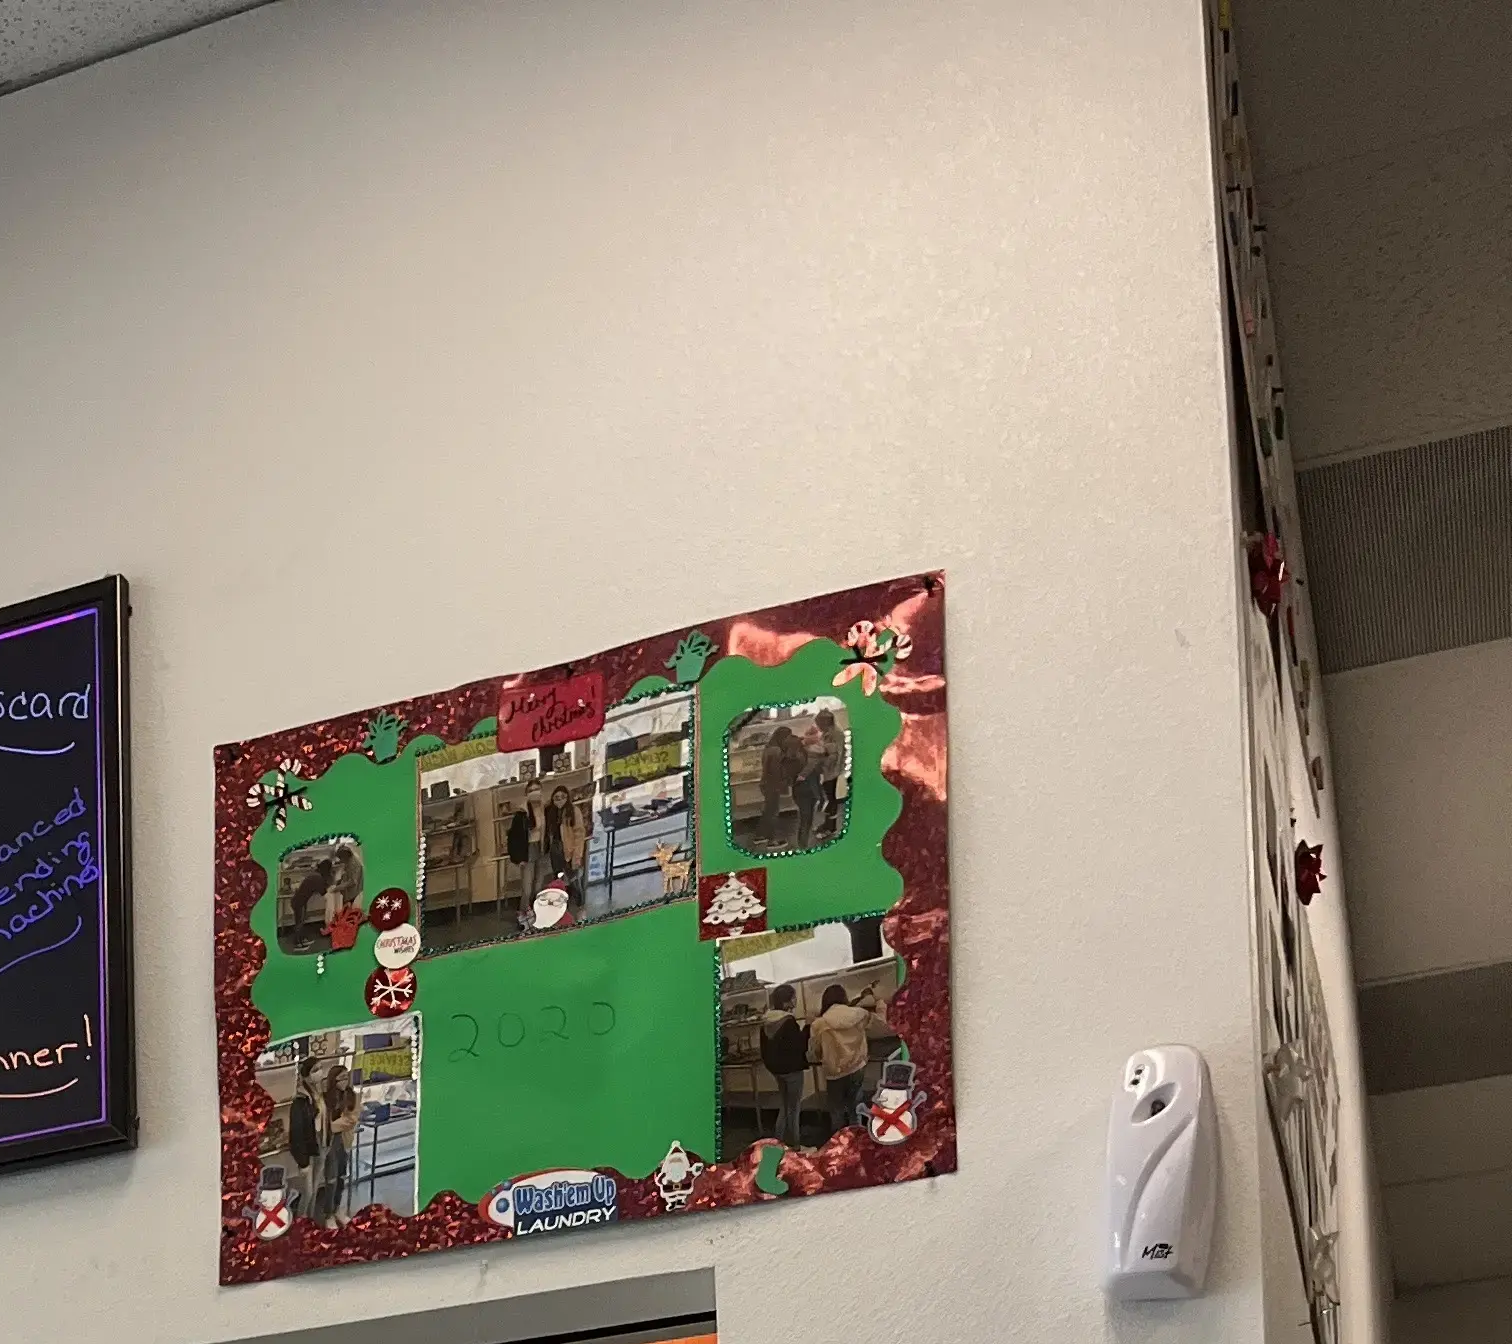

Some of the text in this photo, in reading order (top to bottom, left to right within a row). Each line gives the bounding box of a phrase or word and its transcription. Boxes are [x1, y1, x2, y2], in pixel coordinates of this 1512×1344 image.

[448, 998, 618, 1065] 2020
[591, 1175, 617, 1206] Up
[516, 1206, 617, 1236] LAUNDRY
